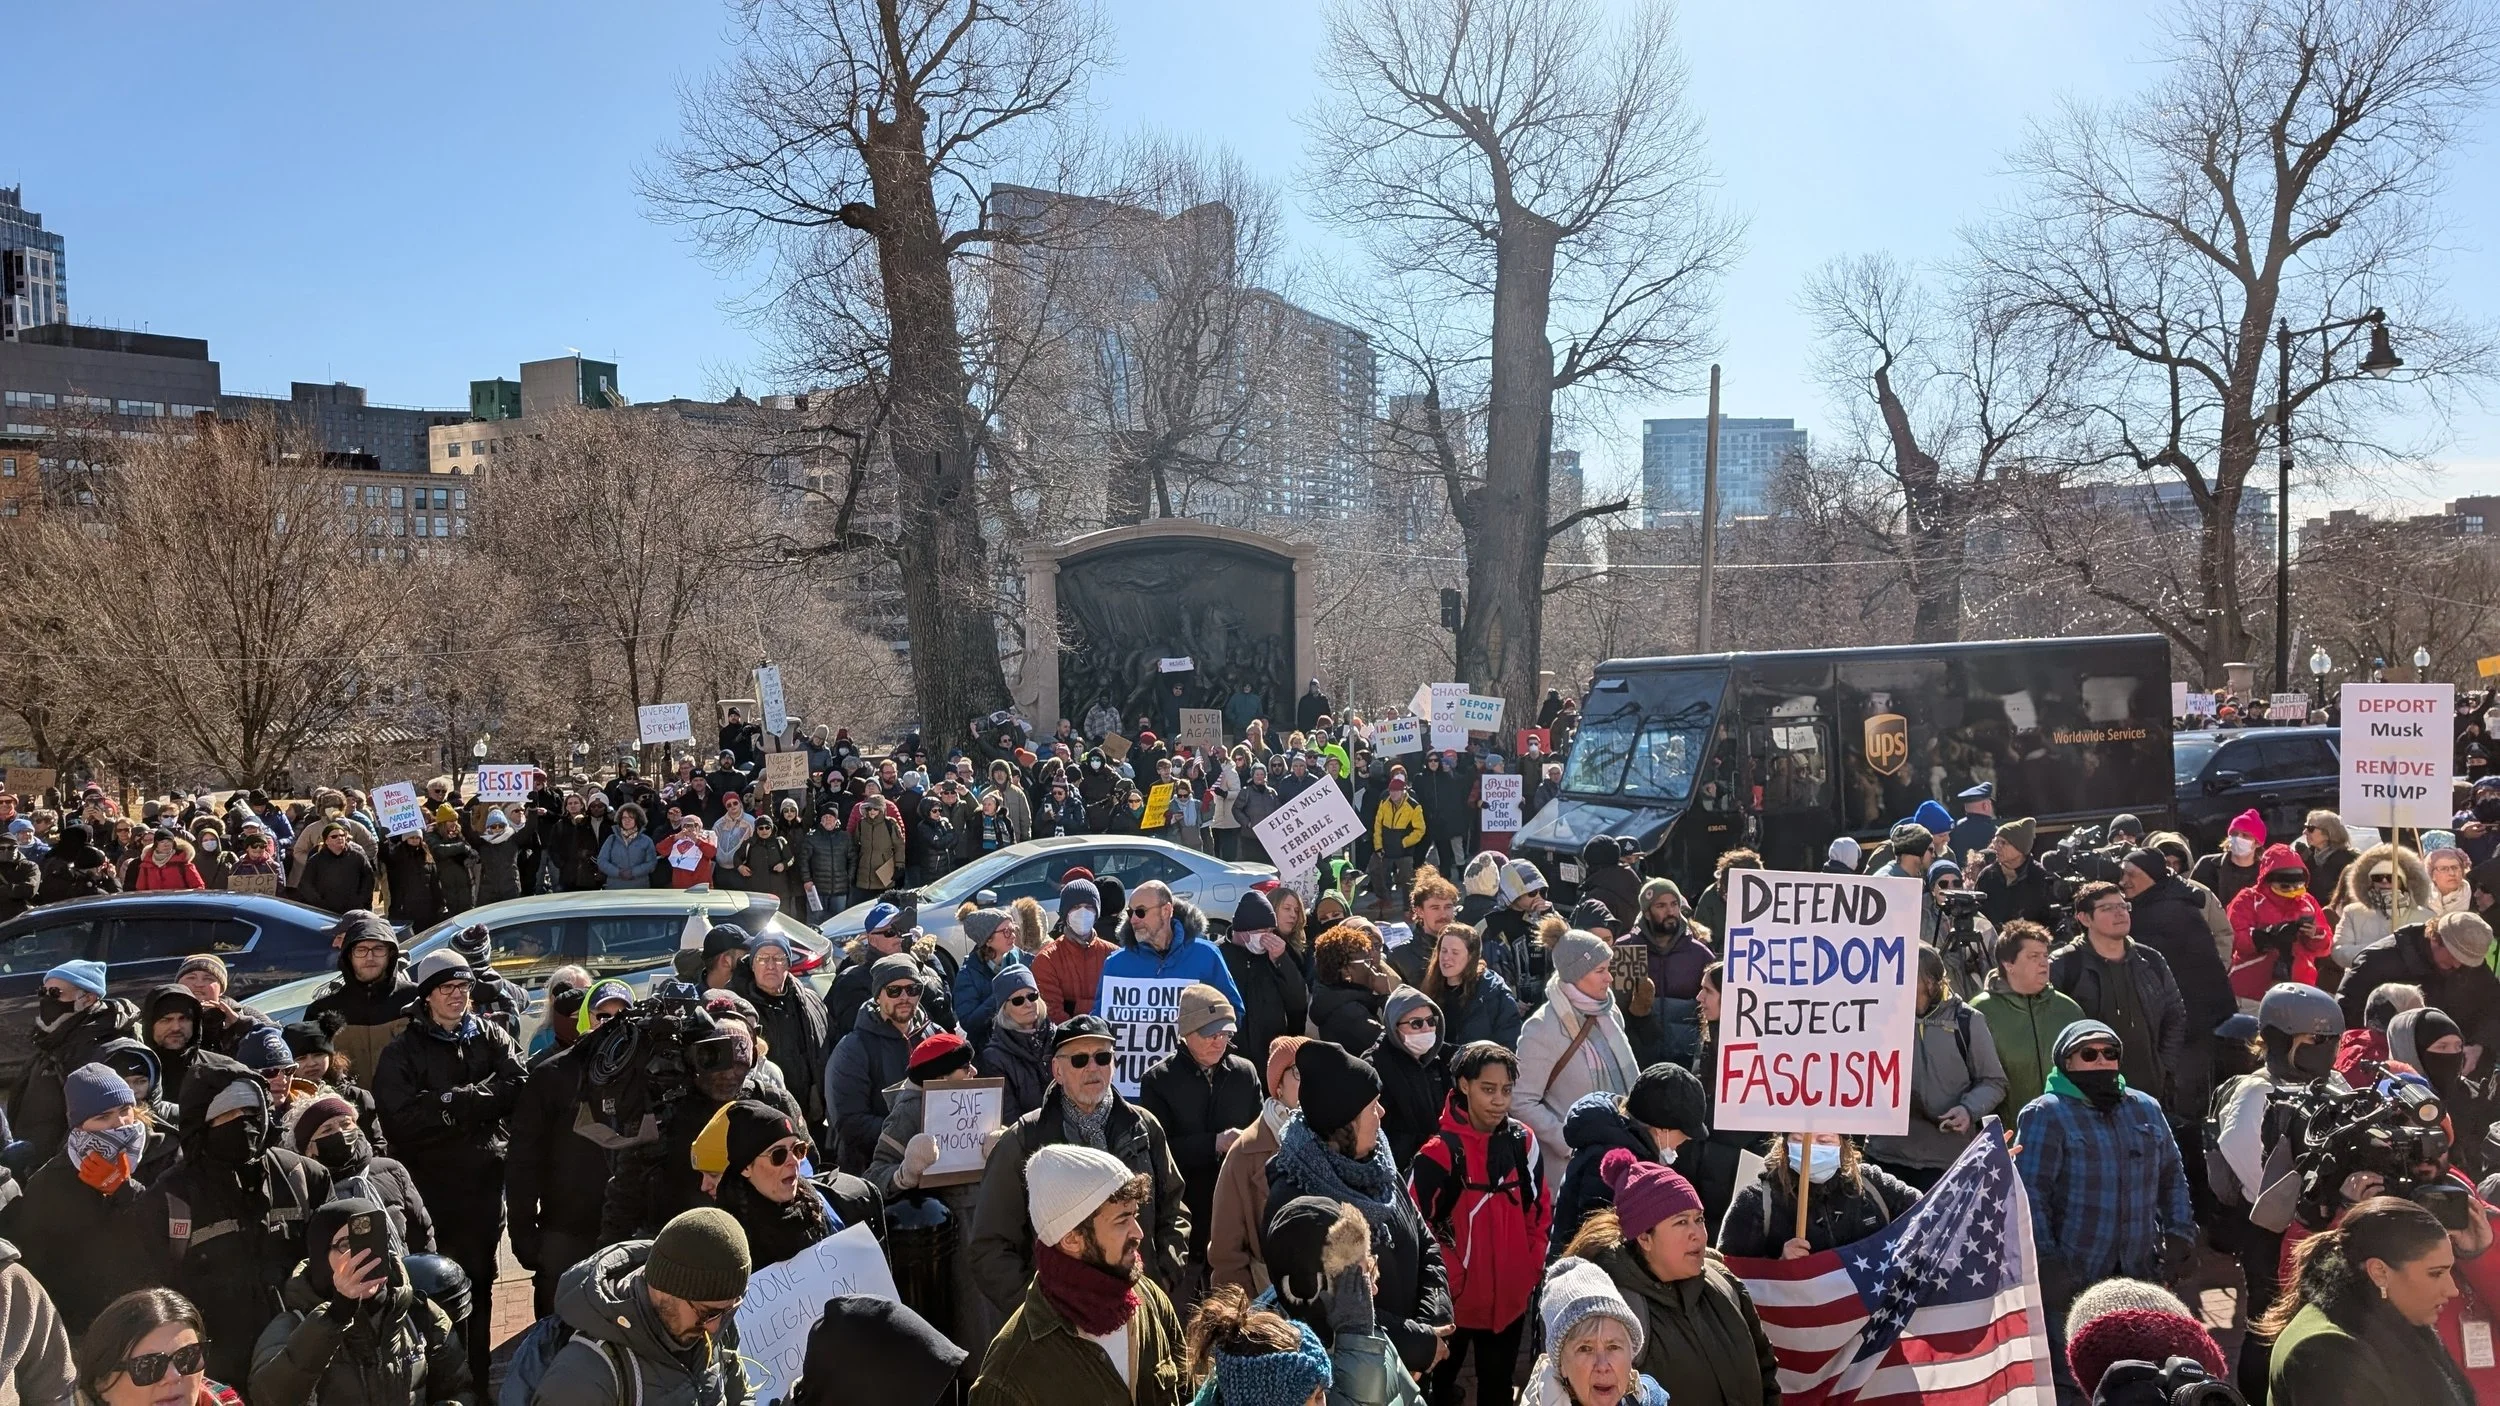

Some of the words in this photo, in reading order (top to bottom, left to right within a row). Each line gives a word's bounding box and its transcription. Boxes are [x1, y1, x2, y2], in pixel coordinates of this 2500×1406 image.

[1432, 687, 1469, 697] CHAOS
[639, 705, 682, 717] DIVERSITY
[1460, 698, 1501, 711] DEPORT
[2358, 699, 2437, 713] DEPORT
[1433, 712, 1455, 721] GOO
[1465, 710, 1493, 721] ELON
[643, 720, 689, 736] STRENGTH
[1376, 721, 1418, 733] IMPEACH
[2371, 723, 2423, 737] Musk
[1381, 734, 1414, 746] TRUMP
[2053, 729, 2105, 744] Worldwide
[2107, 727, 2147, 740] Services
[1868, 731, 1905, 766] ups
[2356, 760, 2436, 776] REMOVE
[478, 771, 532, 791] RESIST
[1504, 779, 1520, 788] the
[384, 790, 401, 800] HATE
[1485, 790, 1516, 801] people
[2361, 784, 2427, 800] TRUMP
[384, 795, 410, 808] NEVER
[1268, 805, 1299, 831] ELON
[1299, 785, 1332, 810] MUSK
[390, 811, 415, 823] NATION
[1494, 811, 1509, 819] the
[392, 819, 417, 832] GREAT
[1282, 825, 1295, 837] IS
[1296, 817, 1304, 828] A
[1487, 819, 1517, 830] people
[1281, 814, 1333, 855] TERRIBLE
[1289, 823, 1351, 868] PRESIDENT
[233, 876, 275, 887] STOP
[1741, 874, 1887, 926] DEFEND
[1727, 927, 1905, 986] FREEDOM
[1112, 986, 1141, 1006] NO
[1113, 1007, 1157, 1022] VOTED
[1161, 1008, 1179, 1023] FO
[1736, 988, 1879, 1038] REJECT
[1721, 1042, 1900, 1109] FASCISM
[949, 1091, 983, 1117] SAVE
[956, 1116, 979, 1131] OUR
[814, 1244, 838, 1273] IS
[743, 1295, 824, 1361] ILLEGAL
[831, 1272, 857, 1299] ON
[2181, 1367, 2204, 1376] Canon
